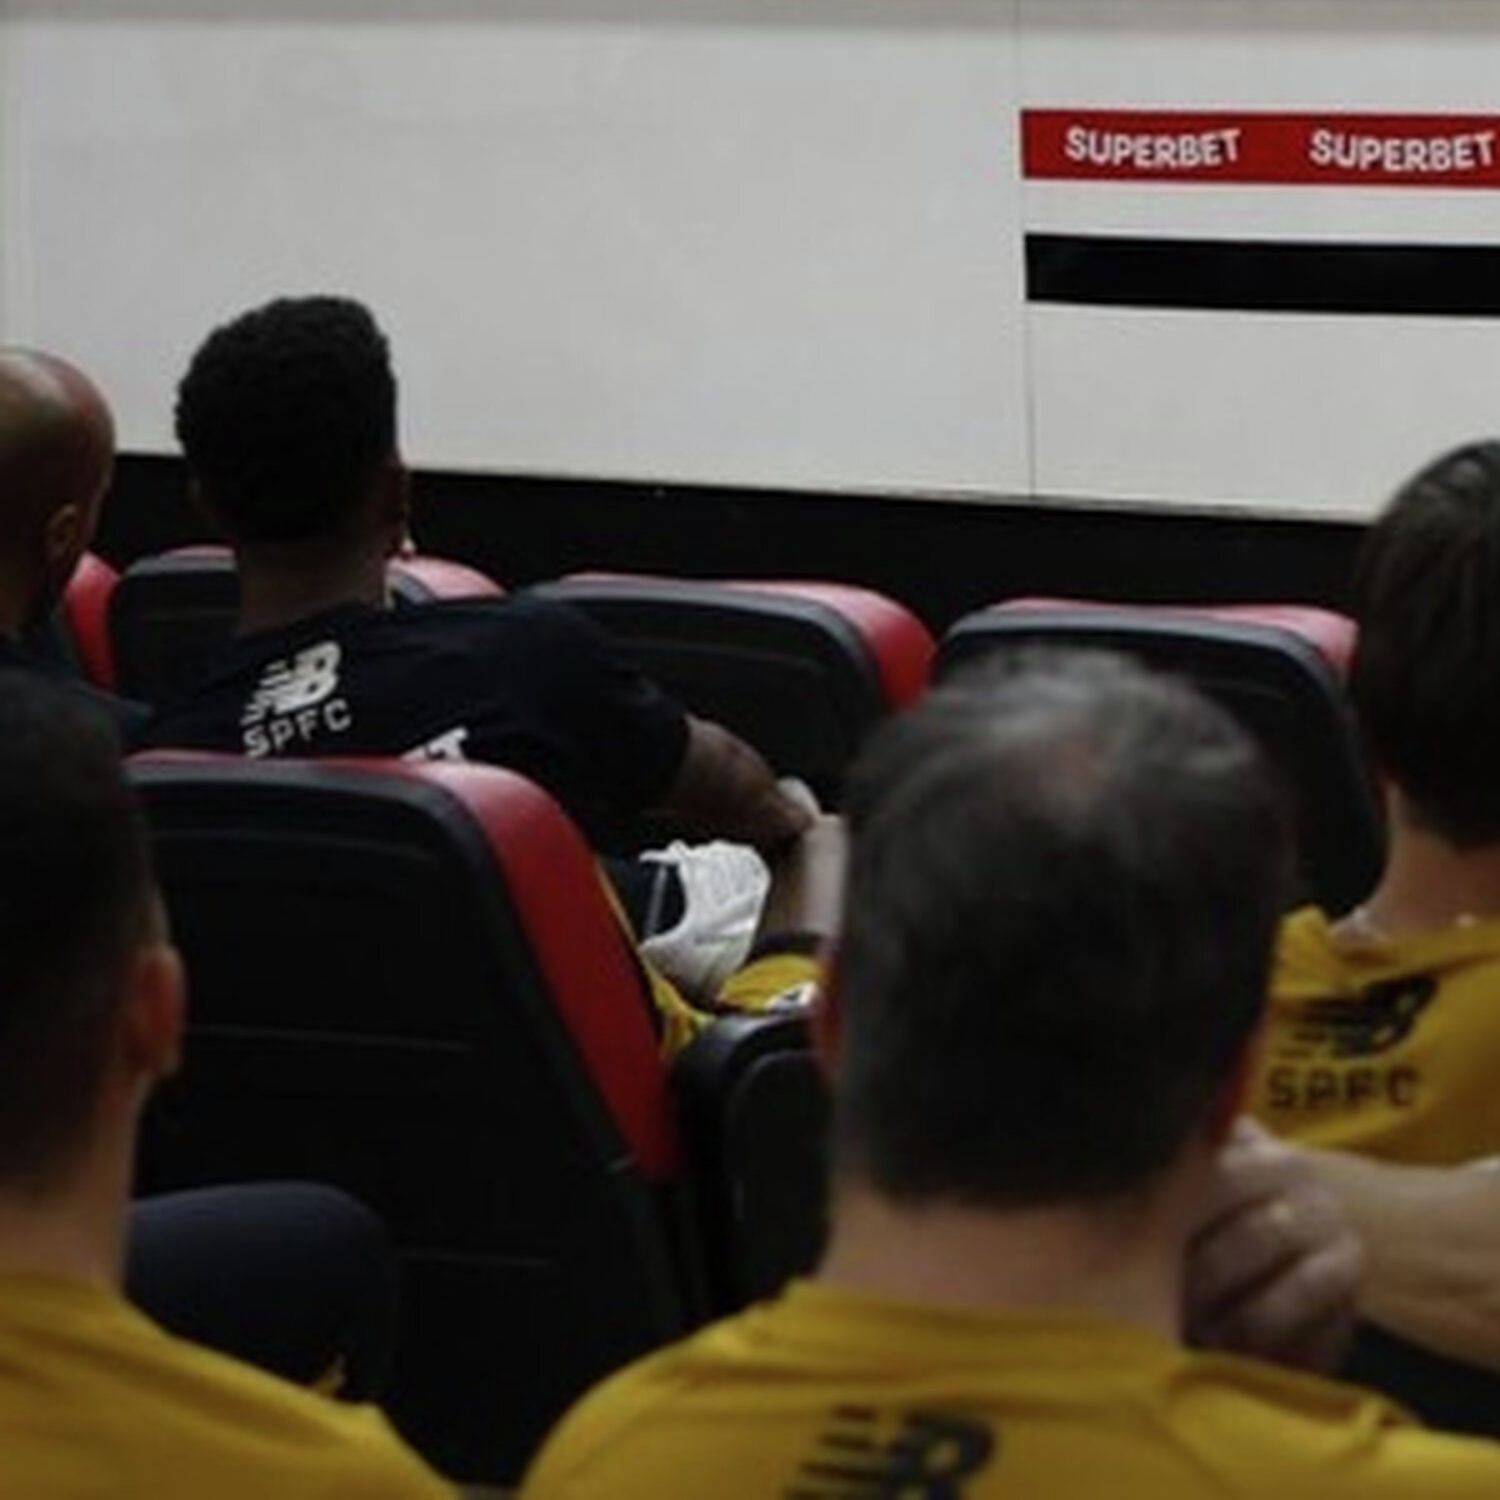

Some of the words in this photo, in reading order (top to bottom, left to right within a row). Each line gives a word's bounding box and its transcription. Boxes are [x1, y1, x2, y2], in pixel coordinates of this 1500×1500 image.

[1066, 127, 1242, 169] SUPERBET
[1309, 129, 1497, 172] SUPERBET
[242, 700, 352, 758] SPFC
